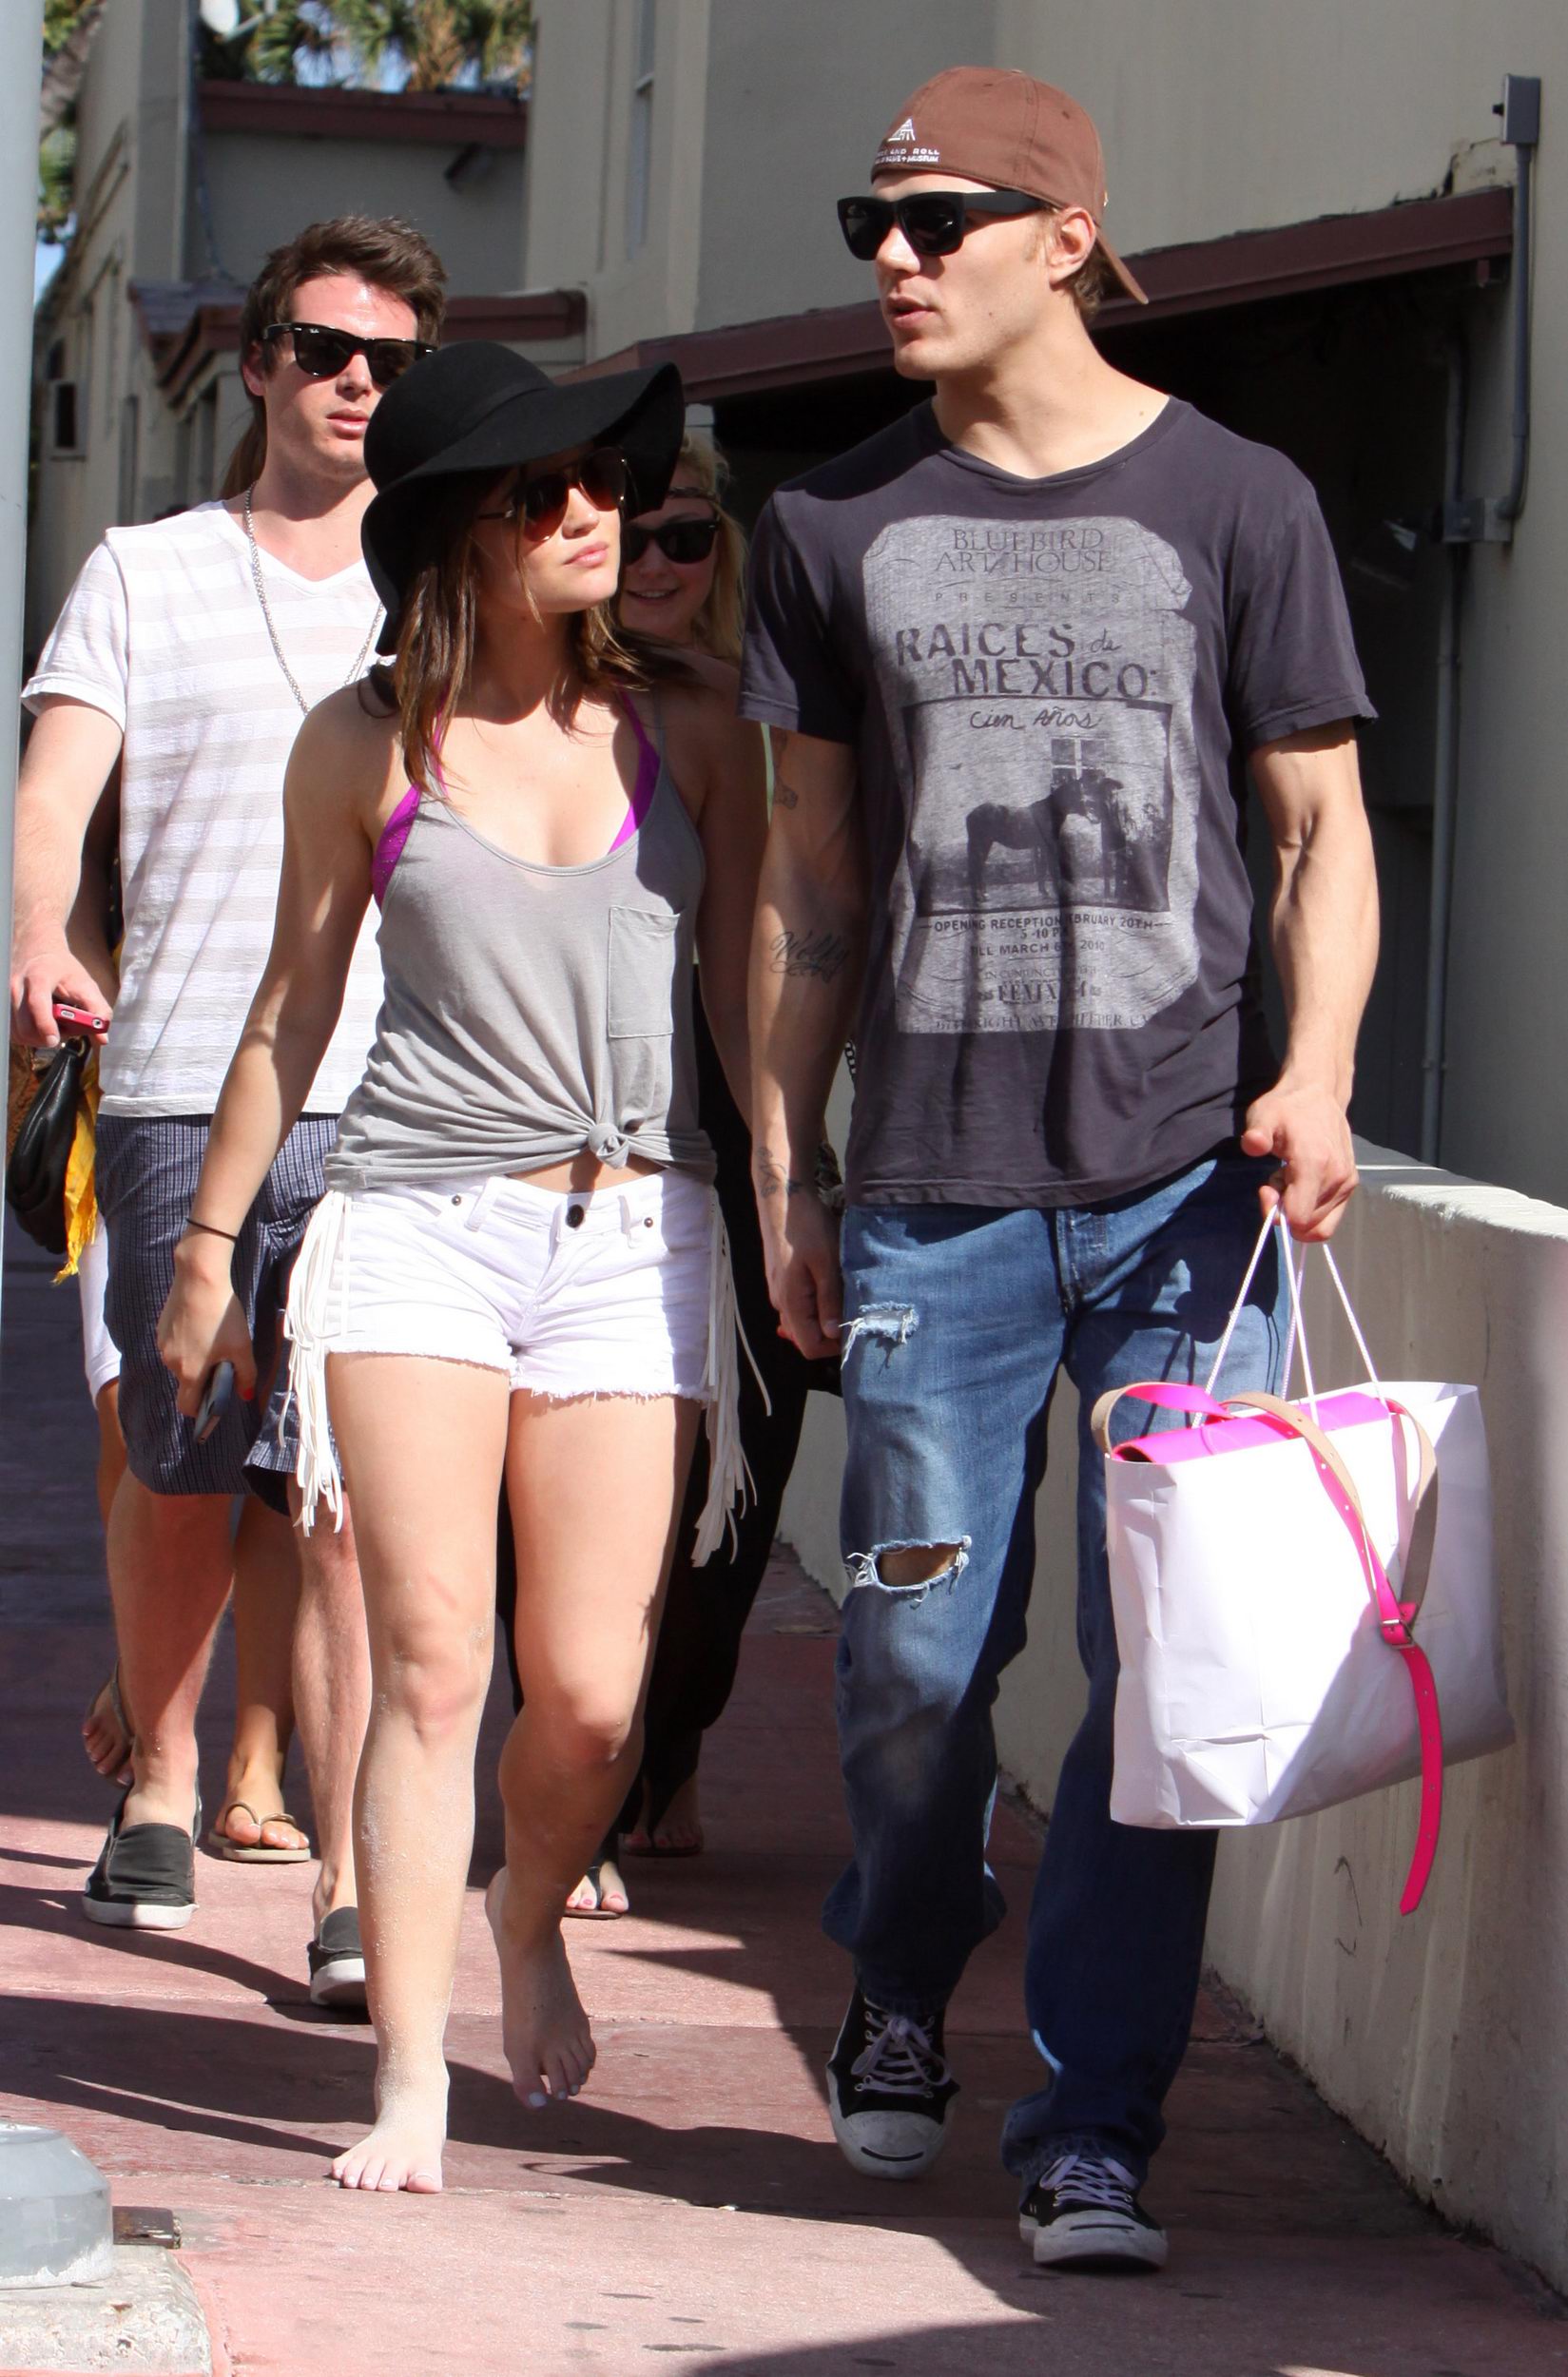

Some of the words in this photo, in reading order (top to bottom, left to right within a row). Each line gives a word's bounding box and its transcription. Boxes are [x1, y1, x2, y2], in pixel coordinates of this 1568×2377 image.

[953, 528, 1104, 552] BLUEBIRD
[1014, 550, 1111, 573] HOUSE
[935, 592, 1120, 603] PRESENTS
[896, 622, 1075, 667] RAICES
[1090, 628, 1122, 653] de
[934, 919, 986, 932] OPENING
[990, 916, 1062, 930] RECEPTION
[1064, 914, 1115, 925] EBRUARY
[1119, 917, 1153, 930] 20TH
[999, 942, 1049, 956] MARCH
[1080, 939, 1105, 952] 2010
